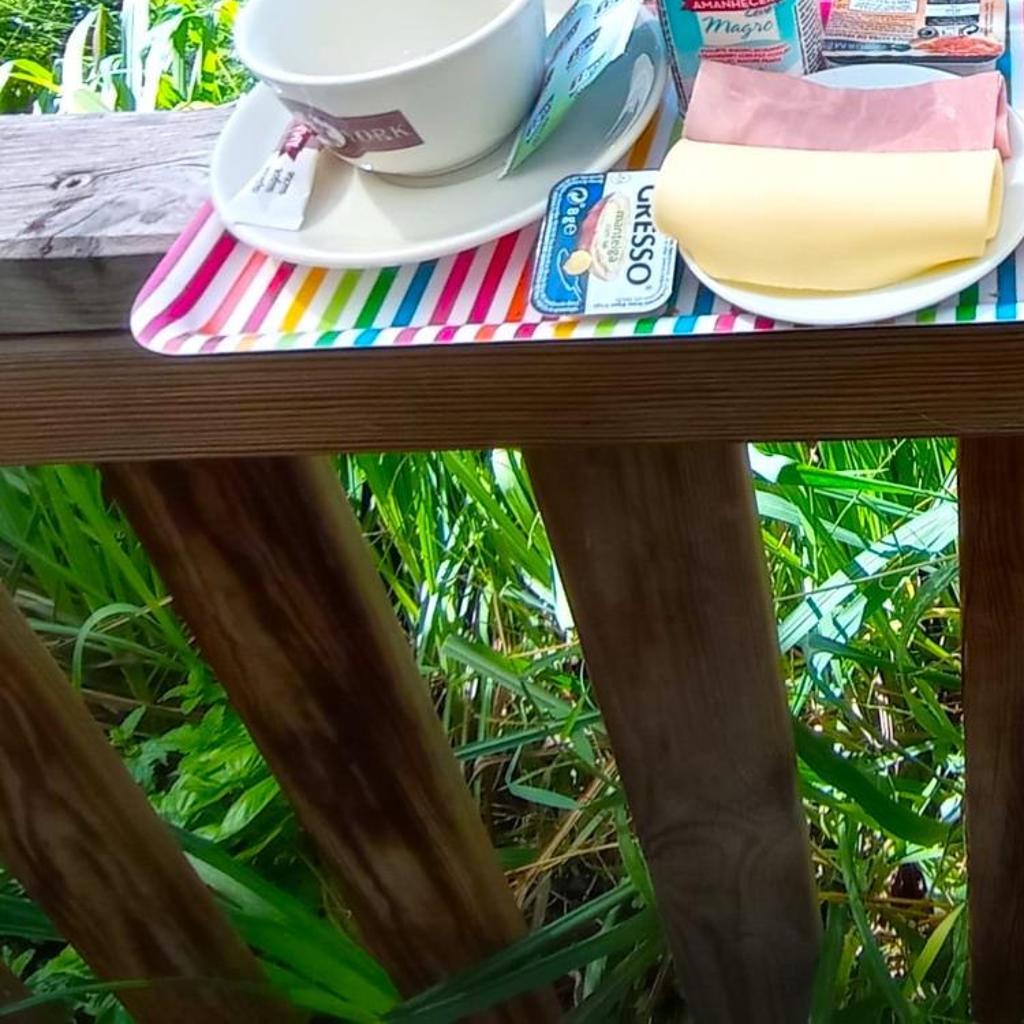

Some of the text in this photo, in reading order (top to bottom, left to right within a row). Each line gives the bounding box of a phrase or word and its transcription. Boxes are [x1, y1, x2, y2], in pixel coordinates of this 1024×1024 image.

[701, 16, 773, 39] Magro
[345, 123, 410, 144] ORK
[607, 209, 625, 264] manteiga
